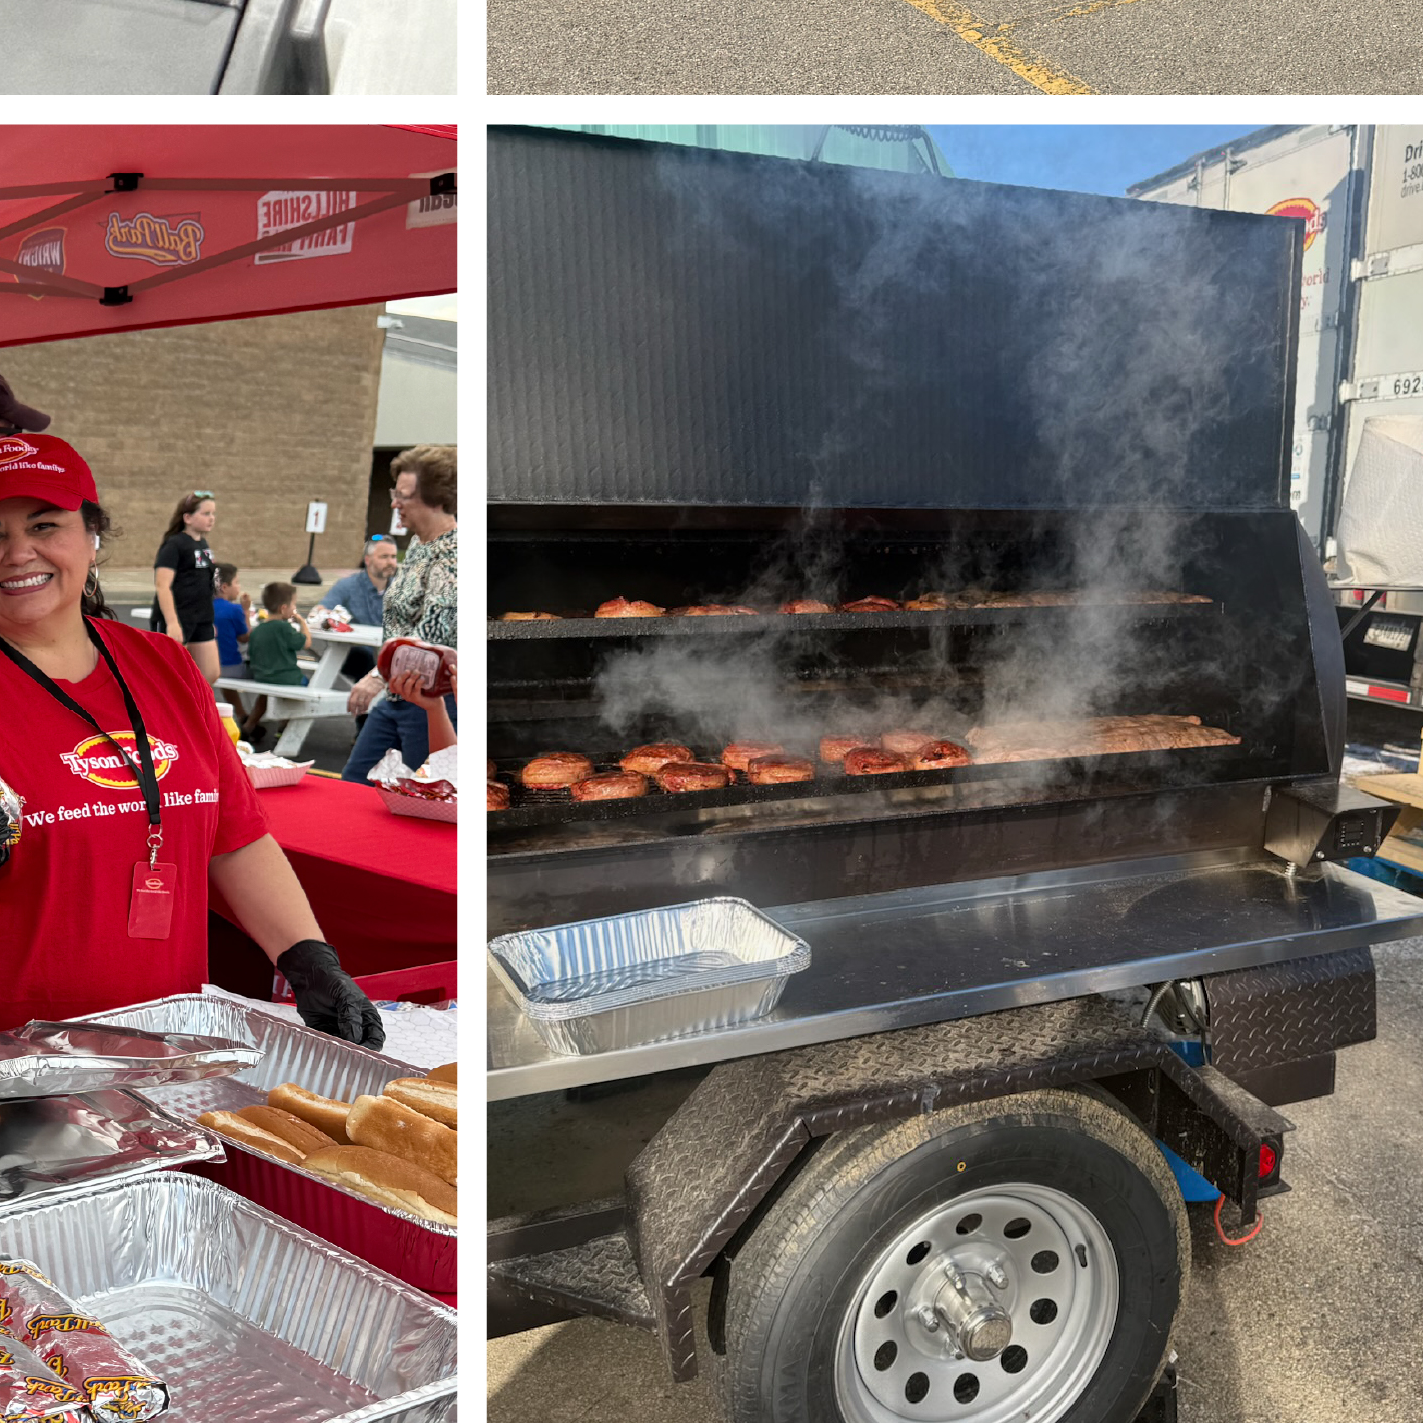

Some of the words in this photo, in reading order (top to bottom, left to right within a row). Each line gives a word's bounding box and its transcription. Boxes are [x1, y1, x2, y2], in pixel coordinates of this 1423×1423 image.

[1301, 268, 1330, 287] orld
[19, 462, 37, 470] like
[64, 753, 123, 775] Tyson
[119, 741, 176, 766] Fods
[24, 810, 55, 827] We
[57, 803, 92, 822] feed
[92, 800, 116, 817] the
[118, 800, 163, 814] wor
[163, 791, 193, 808] like
[29, 1315, 70, 1341] Park
